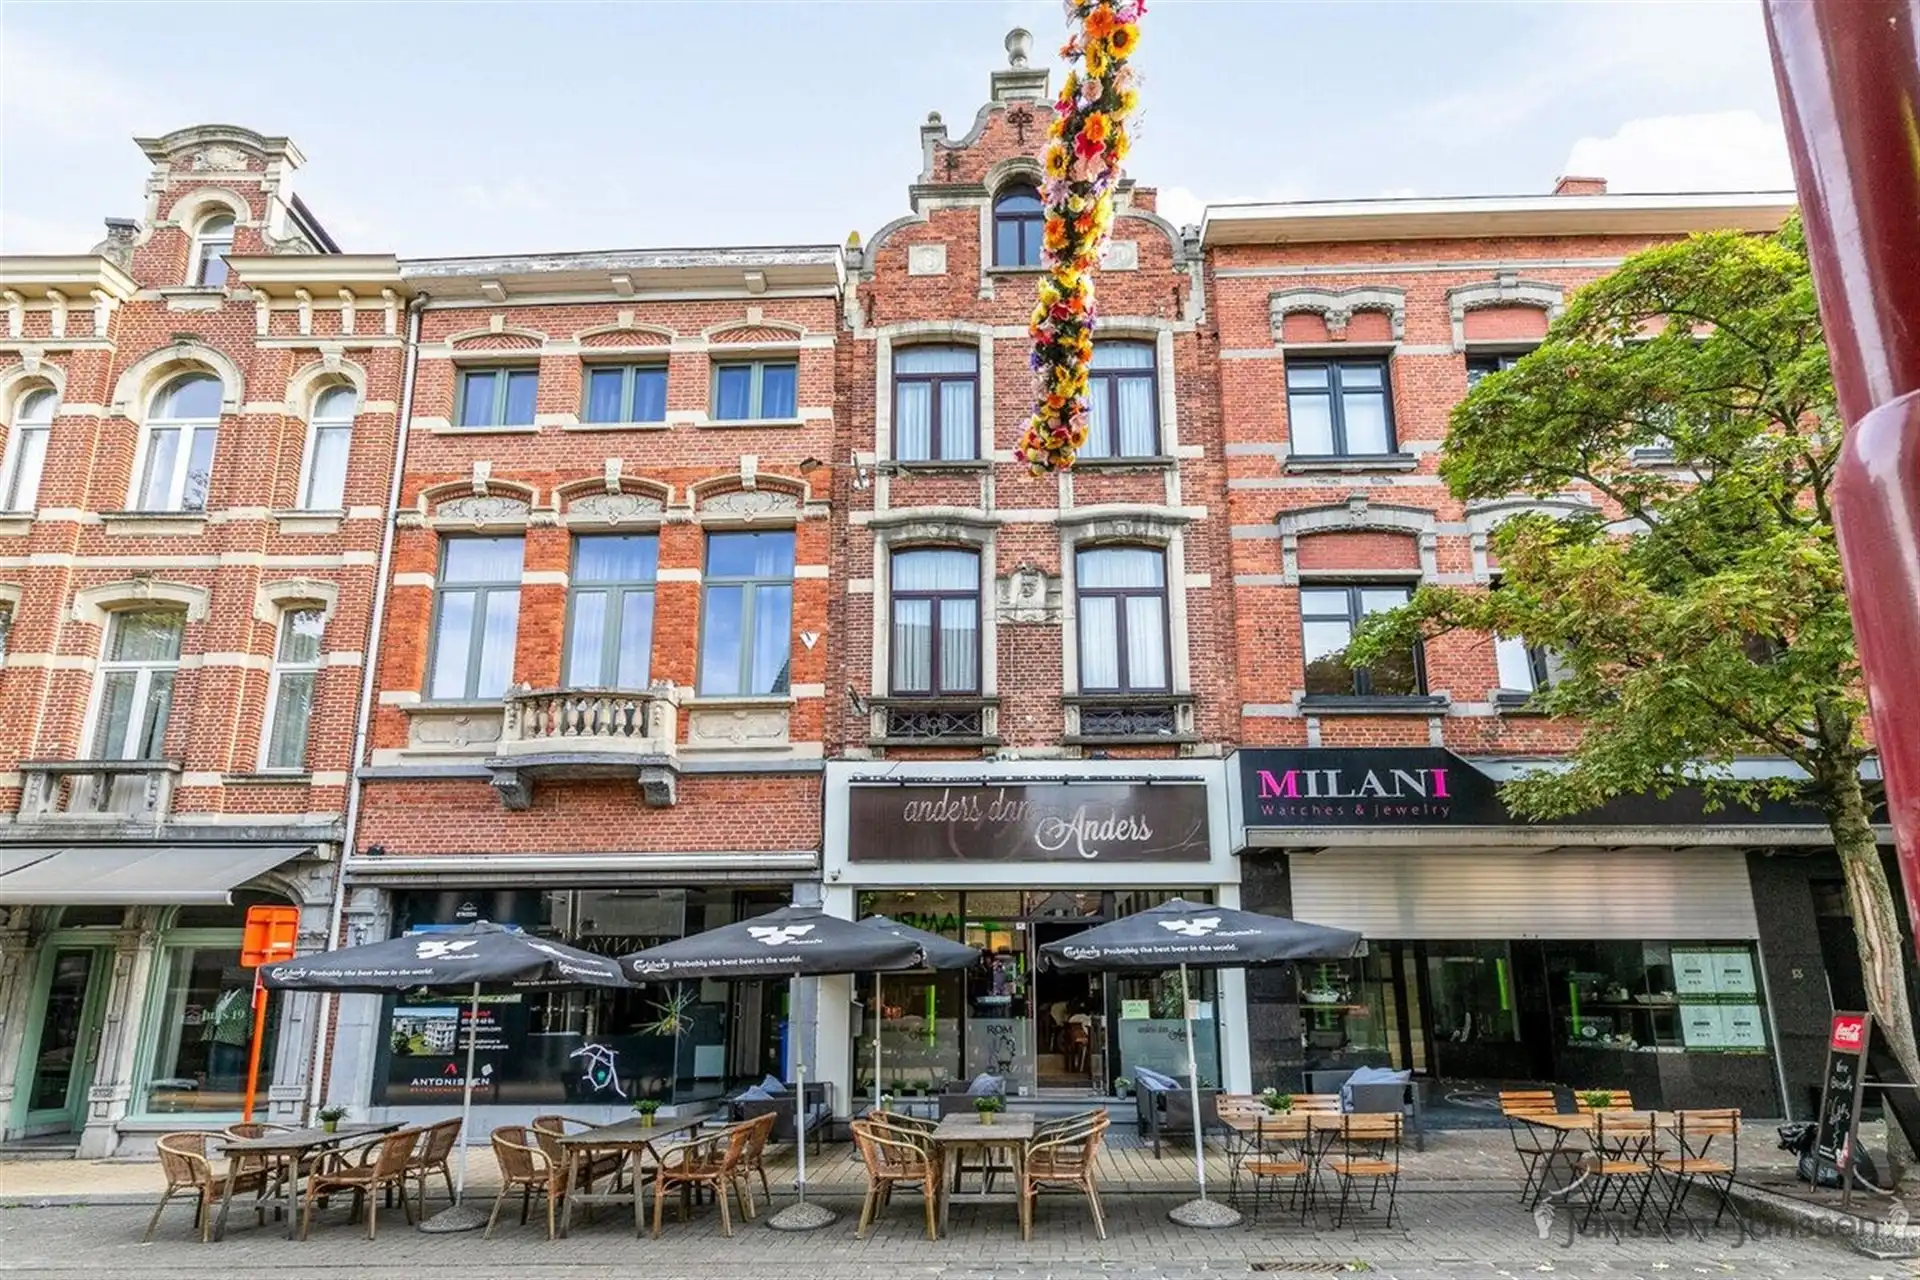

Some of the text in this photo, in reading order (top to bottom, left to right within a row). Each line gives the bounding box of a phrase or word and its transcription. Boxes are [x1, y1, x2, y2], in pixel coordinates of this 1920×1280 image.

[1256, 768, 1451, 798] MILANI
[1261, 804, 1344, 816] Watches
[1355, 803, 1365, 816] &
[903, 788, 982, 821] anders
[1035, 805, 1153, 858] Anders
[673, 959, 708, 968] Probably
[410, 1078, 490, 1087] ANTONISEN
